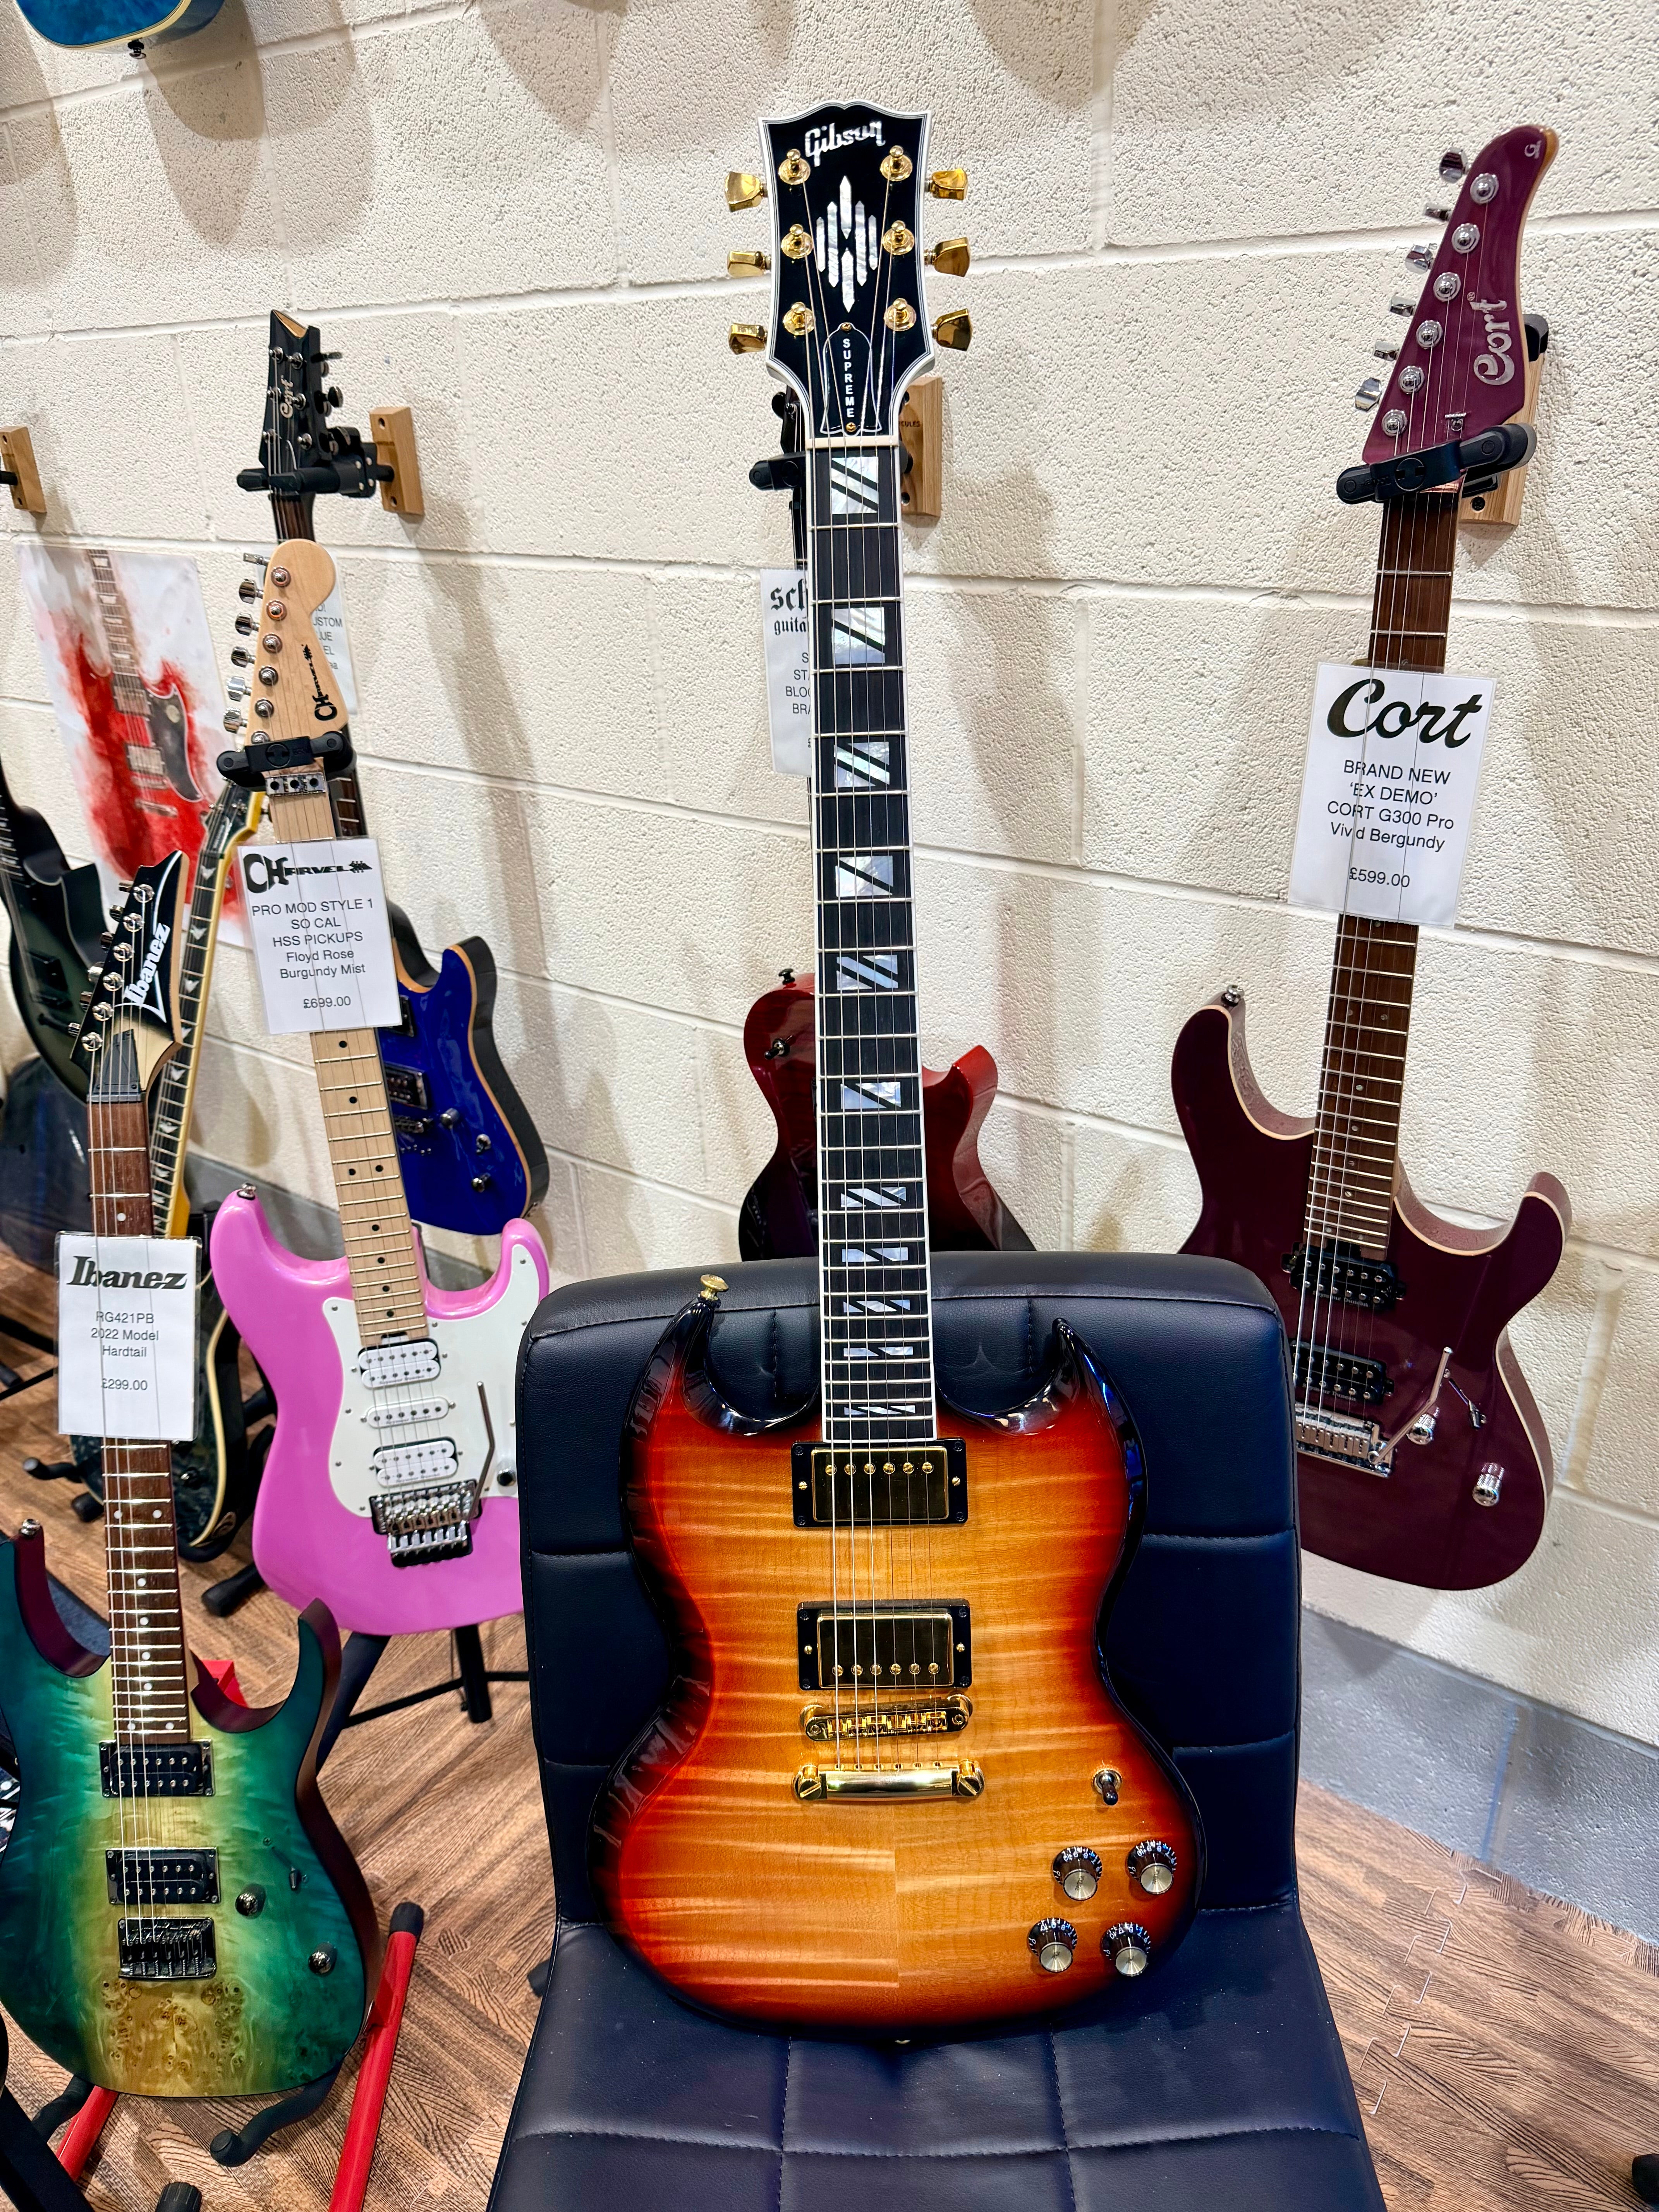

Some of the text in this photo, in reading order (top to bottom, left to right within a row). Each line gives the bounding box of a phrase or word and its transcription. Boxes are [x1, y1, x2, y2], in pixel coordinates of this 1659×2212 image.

[804, 120, 886, 167] Gibson
[1469, 299, 1515, 386] Cort
[843, 338, 856, 418] SUPREME
[313, 617, 343, 627] USTOM
[775, 616, 807, 636] guita
[786, 686, 810, 697] BLO
[1327, 678, 1483, 749] Cort
[1343, 759, 1451, 785] BRAND NEW
[1328, 800, 1454, 830] CORT G300 Pro
[1330, 822, 1445, 852] Vivd Bergundy
[1349, 867, 1410, 888] £599.00
[252, 898, 374, 916] PRO MOD STYLE 1
[291, 917, 341, 929] SO CAL
[273, 931, 364, 947] HSS PICKUPS
[124, 923, 170, 1005] Ibanez
[287, 949, 354, 964] Floyd Rose
[280, 963, 366, 980] Burgundy Mist
[303, 996, 351, 1009] £699.00
[66, 1255, 187, 1290] Ibanez
[96, 1311, 155, 1324] RG421PB
[91, 1328, 159, 1341] 2022 Model
[102, 1345, 147, 1357] Hardtail
[101, 1378, 148, 1391] £299.00
